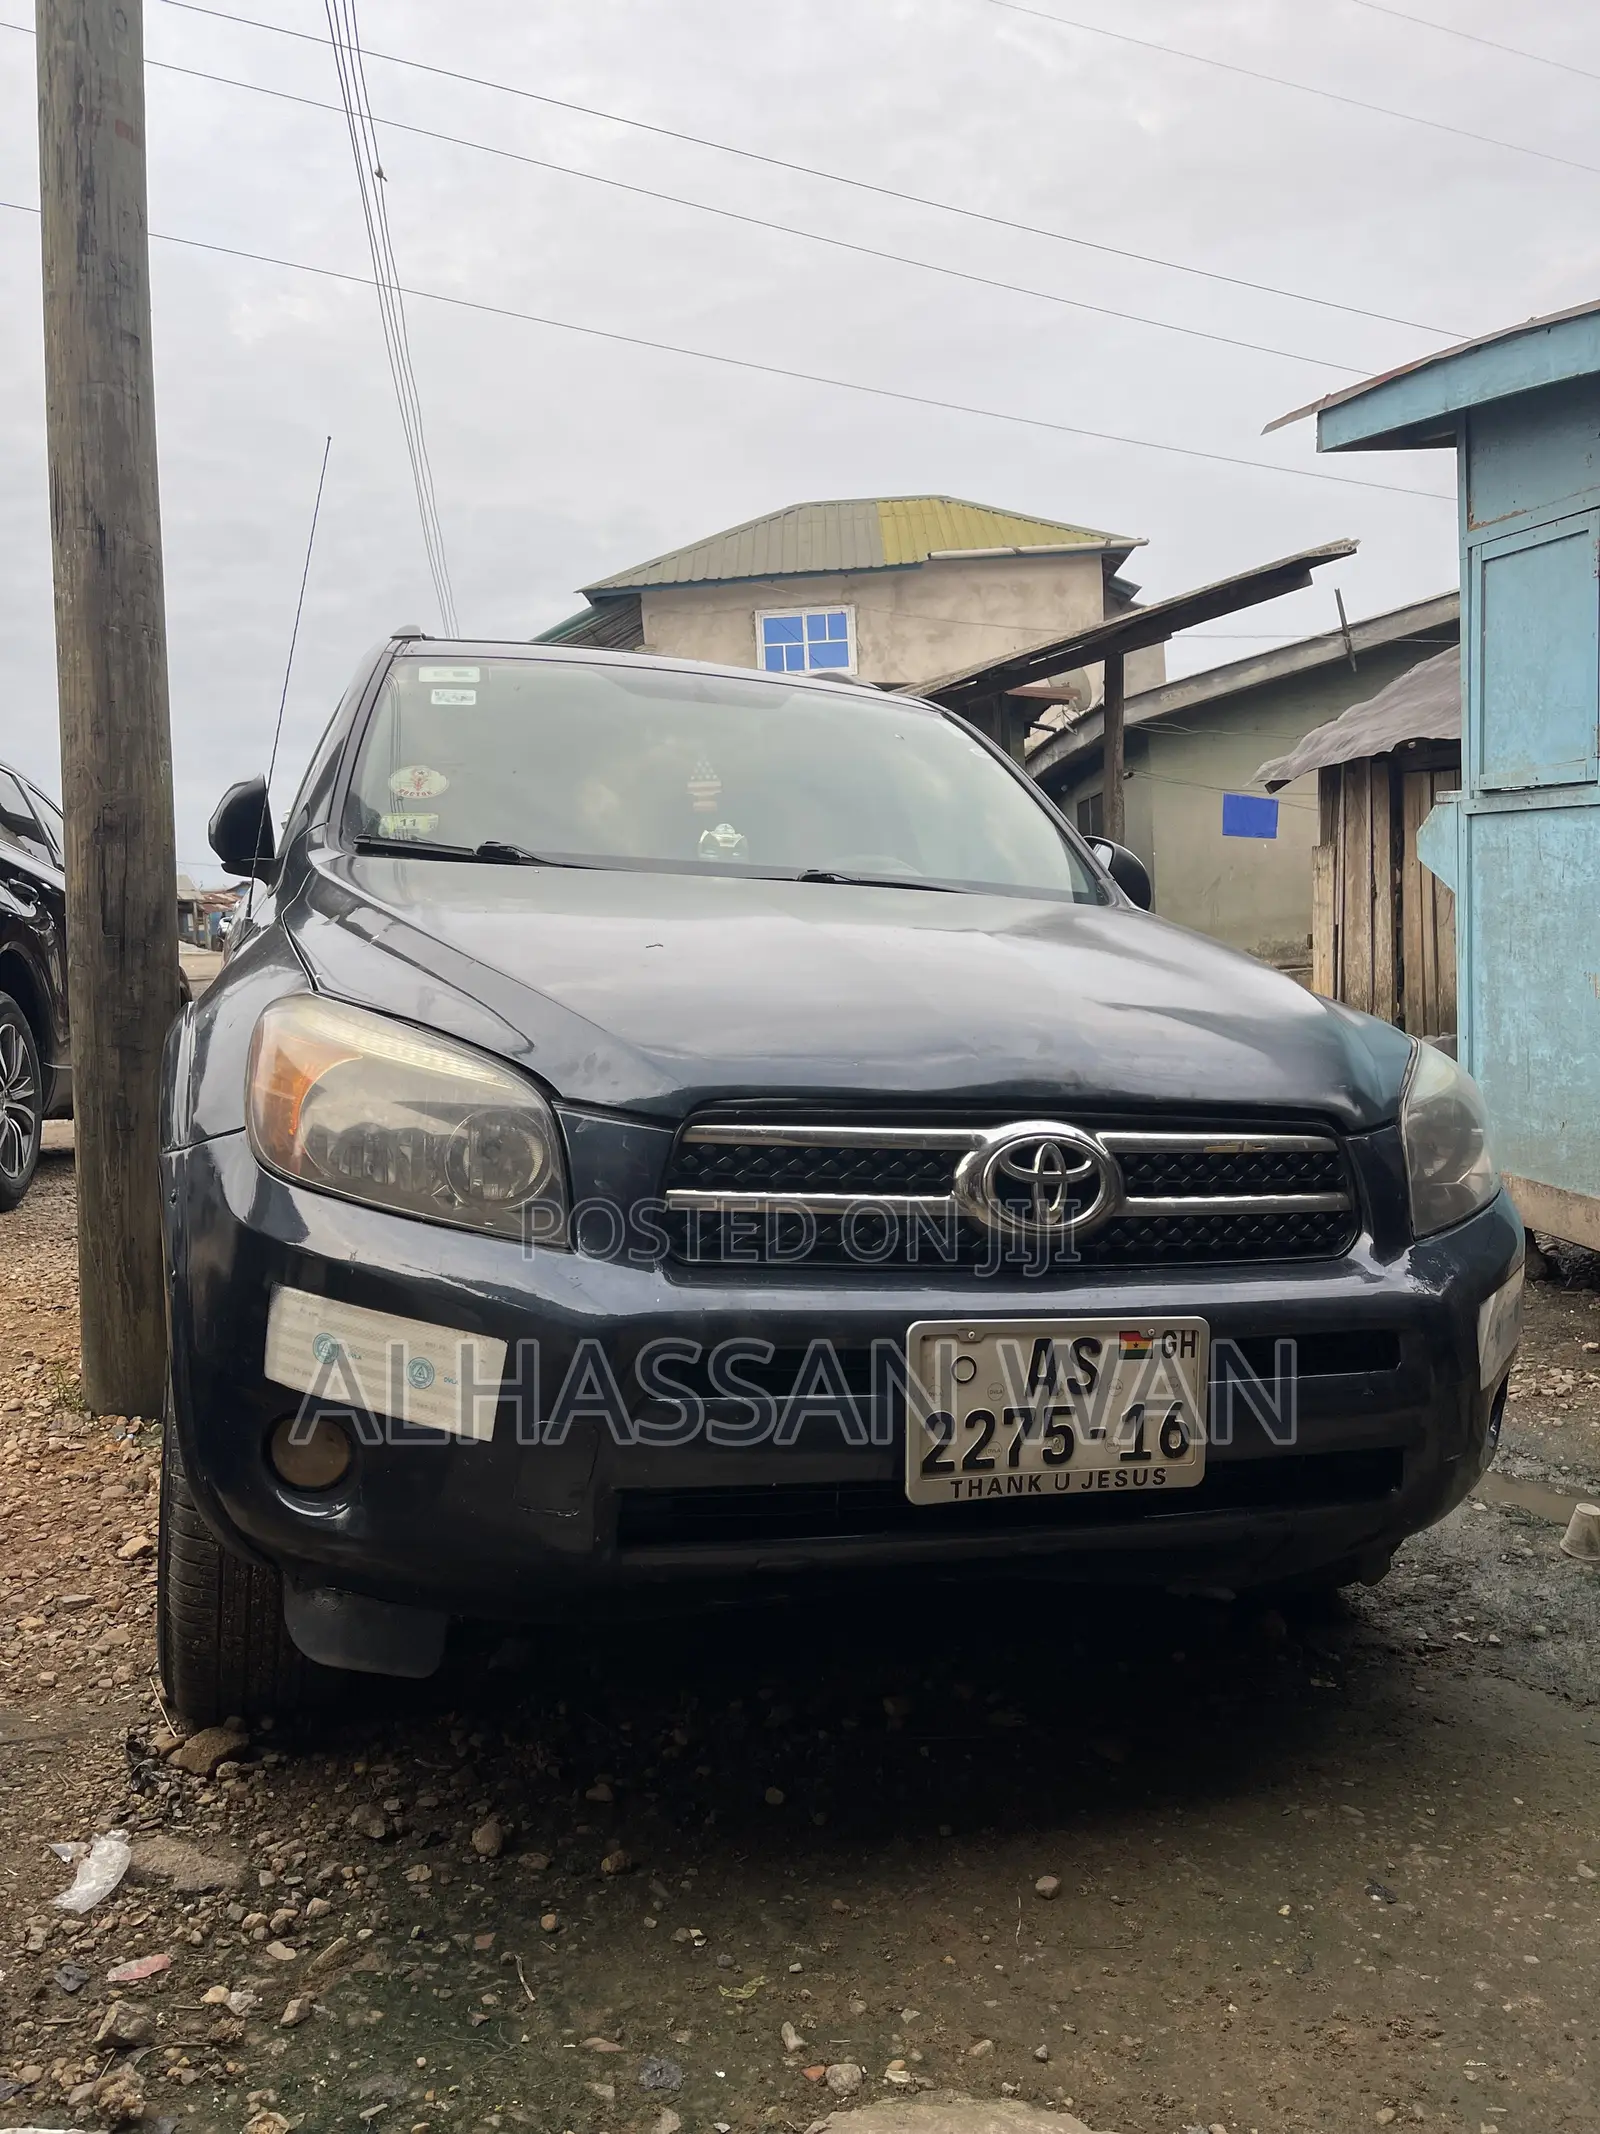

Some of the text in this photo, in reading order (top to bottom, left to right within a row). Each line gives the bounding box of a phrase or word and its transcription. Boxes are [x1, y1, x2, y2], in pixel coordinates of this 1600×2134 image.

[1024, 1336, 1105, 1397] AS
[1161, 1329, 1196, 1359] GH
[920, 1400, 1191, 1474] 2275-16
[950, 1467, 1167, 1500] THANK U JESUS
